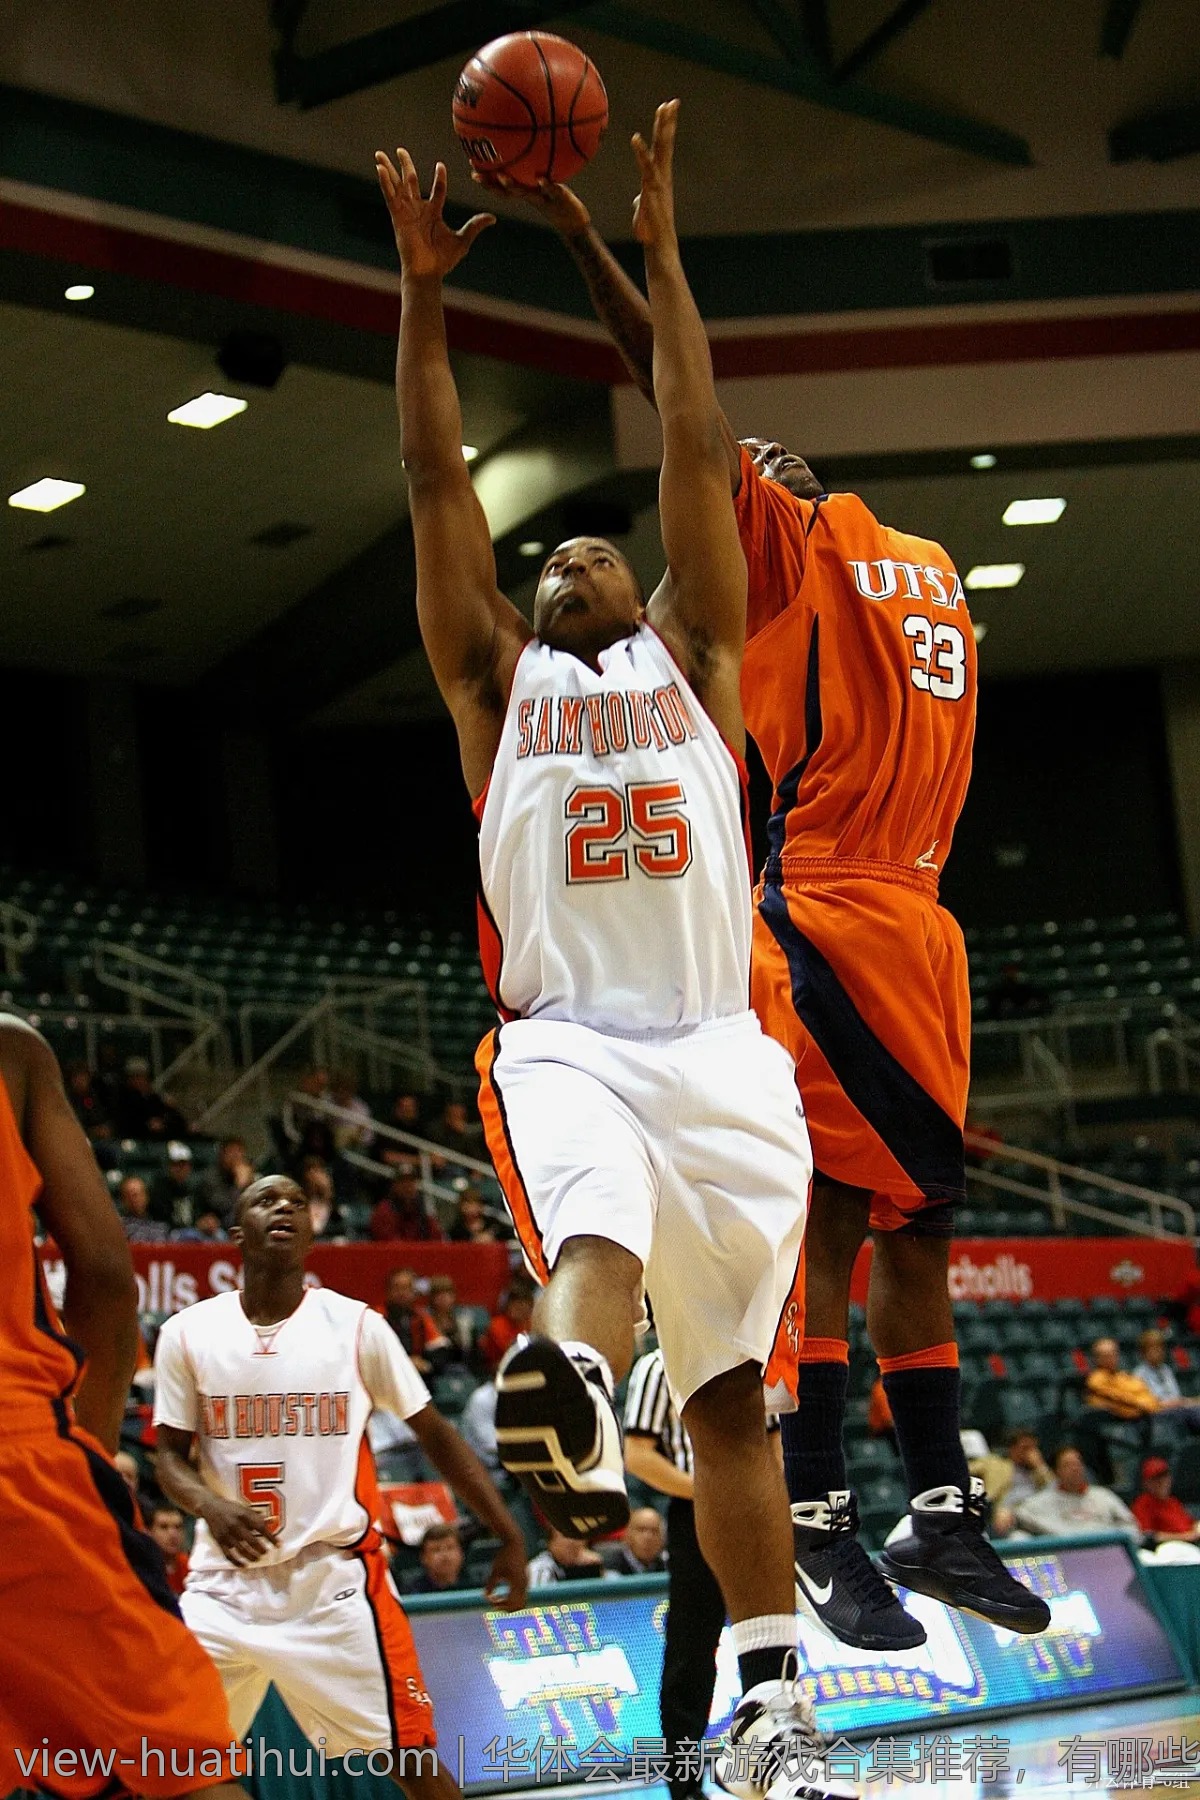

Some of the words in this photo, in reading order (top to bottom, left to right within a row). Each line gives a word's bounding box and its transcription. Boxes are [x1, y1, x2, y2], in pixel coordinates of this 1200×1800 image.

[847, 559, 965, 610] UTSA
[902, 614, 966, 701] 33
[565, 779, 693, 886] 25
[237, 1462, 285, 1537] 5
